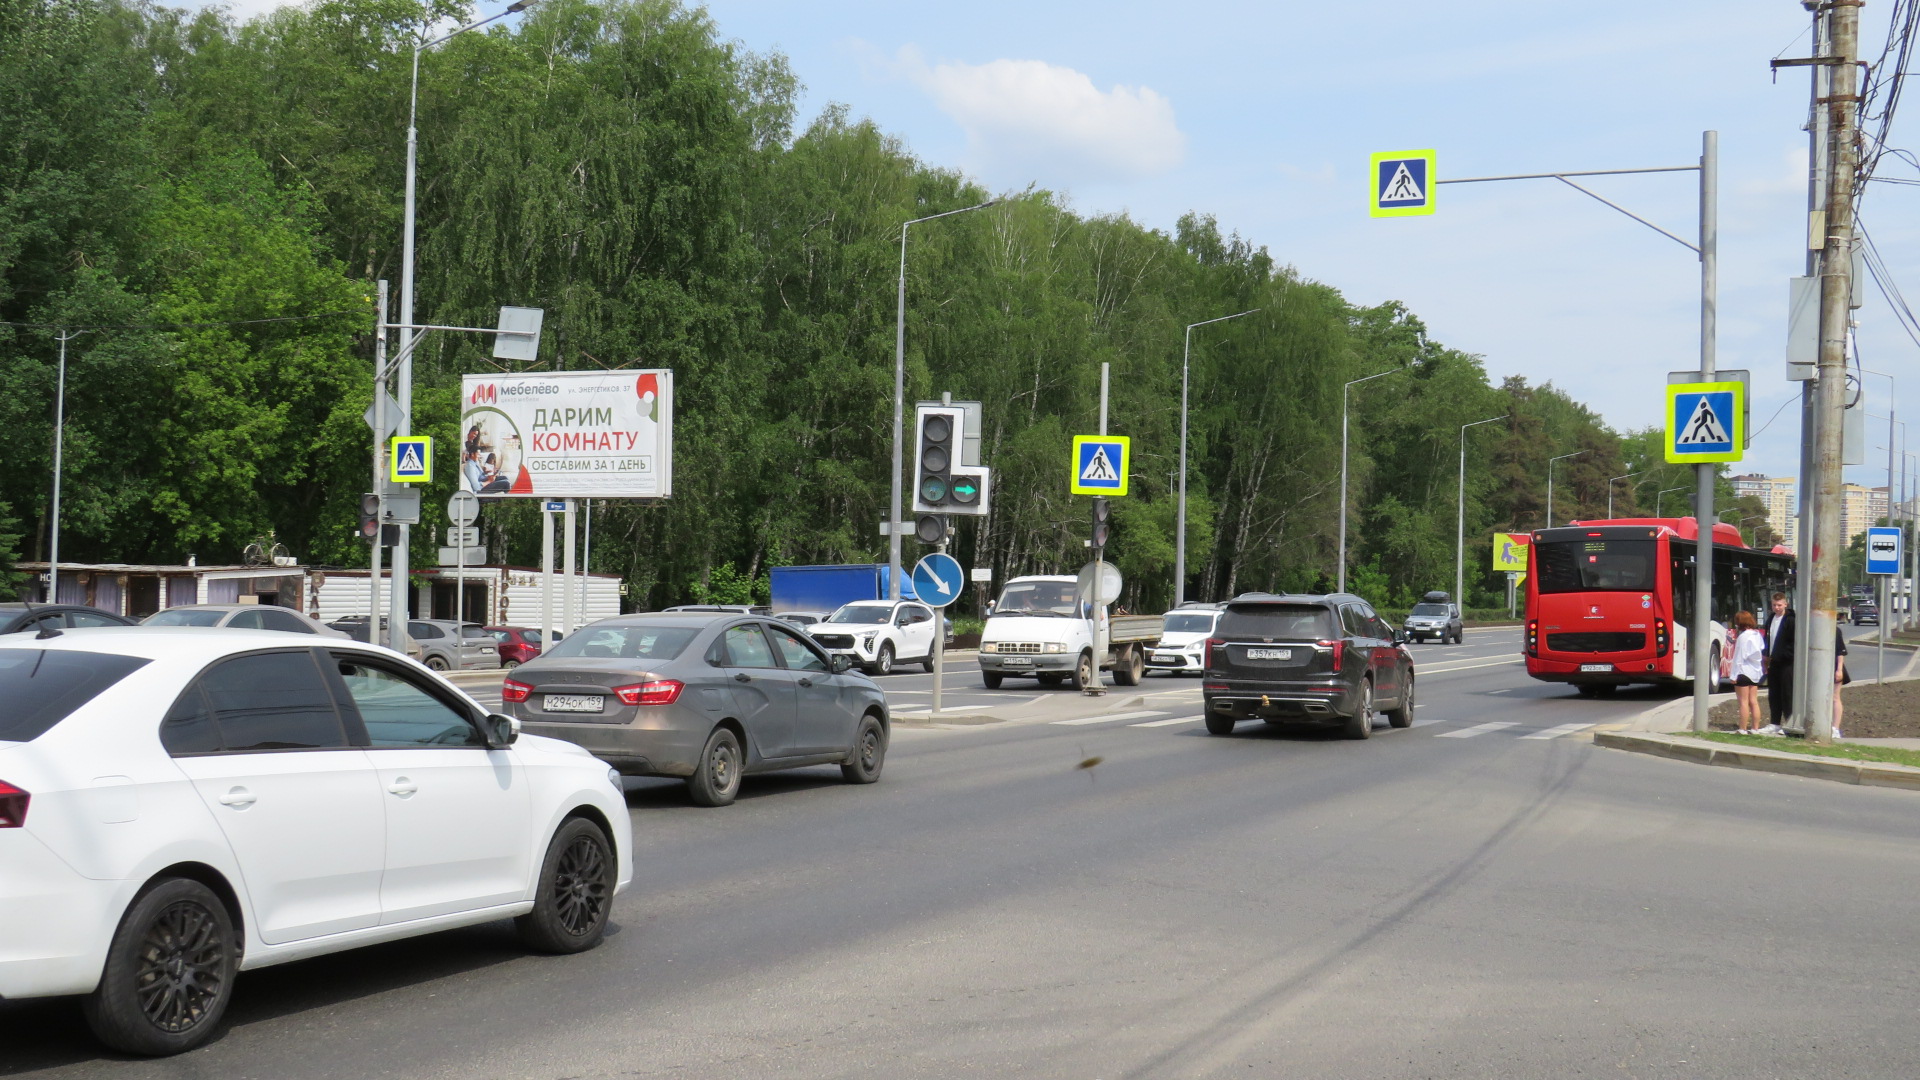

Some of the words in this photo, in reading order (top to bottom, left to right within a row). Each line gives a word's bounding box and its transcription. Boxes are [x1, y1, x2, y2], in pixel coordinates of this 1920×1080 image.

[500, 381, 560, 395] мебелёво
[532, 407, 613, 431] ДАРИМ
[532, 431, 639, 452] КОМНАТУ
[532, 459, 592, 472] ОБСТАВИМ
[594, 459, 608, 471] ЗА
[610, 460, 615, 470] 1
[617, 458, 646, 472] ДЕНЬ
[546, 696, 584, 709] М294ОК
[586, 696, 602, 706] 159
